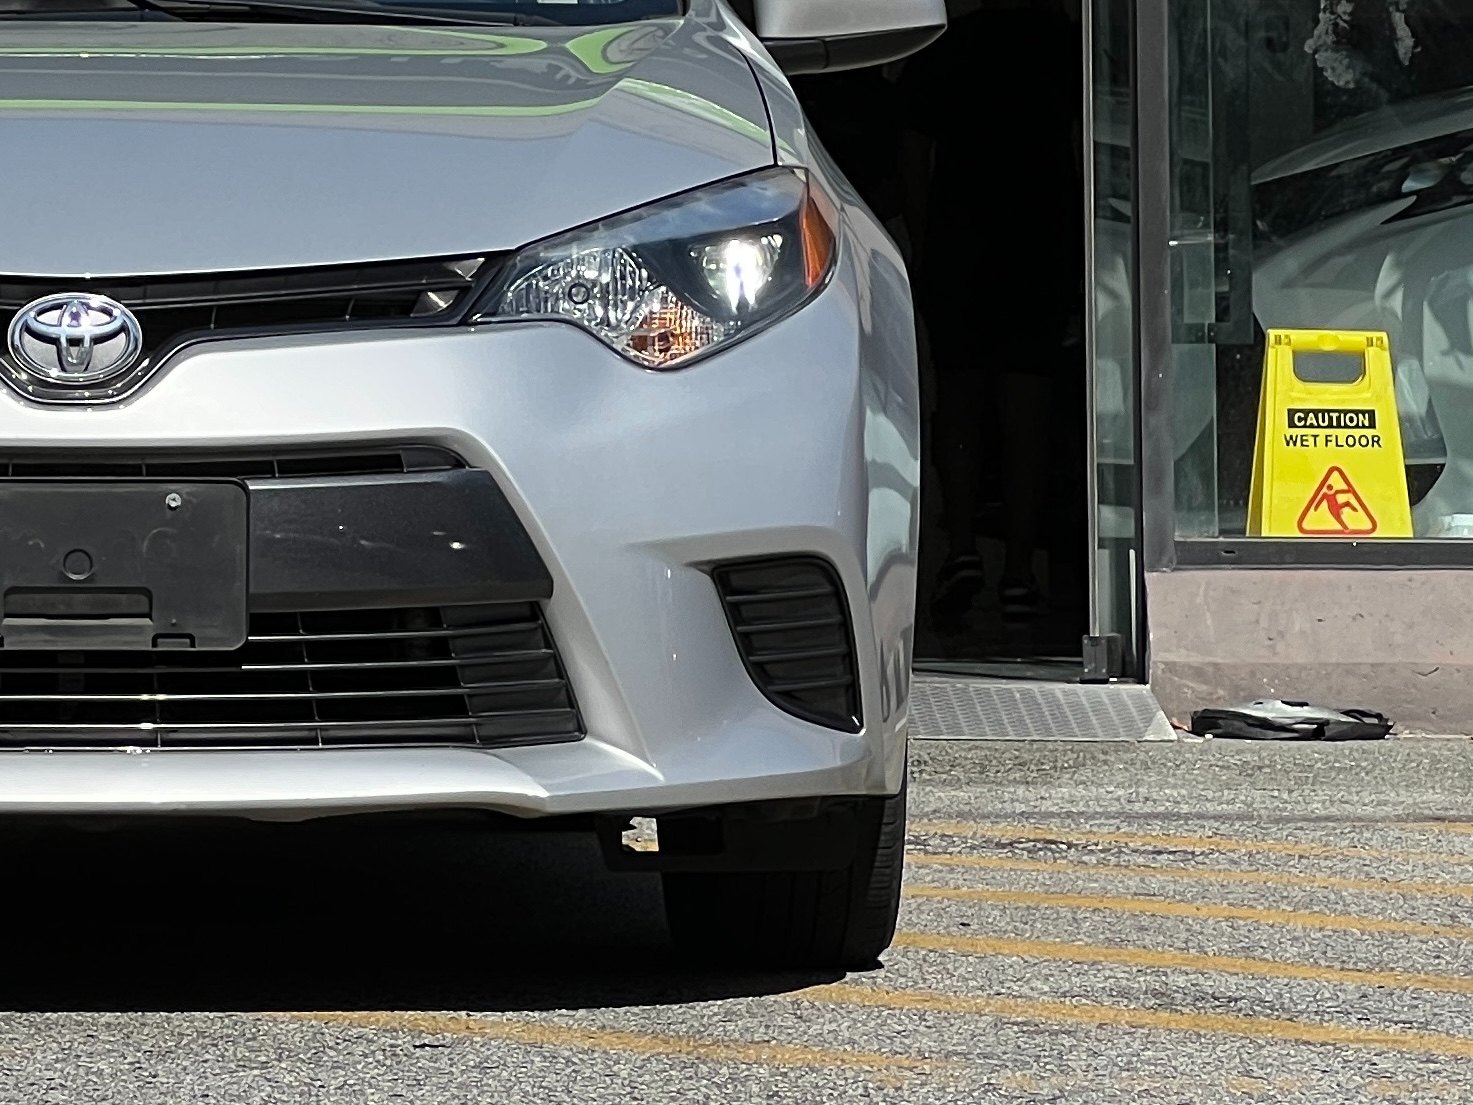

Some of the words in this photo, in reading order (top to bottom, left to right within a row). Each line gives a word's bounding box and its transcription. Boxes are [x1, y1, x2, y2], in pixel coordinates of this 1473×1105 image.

[1294, 412, 1369, 427] CAUTION
[1284, 434, 1320, 448] WET
[1325, 434, 1382, 448] FLOOR
